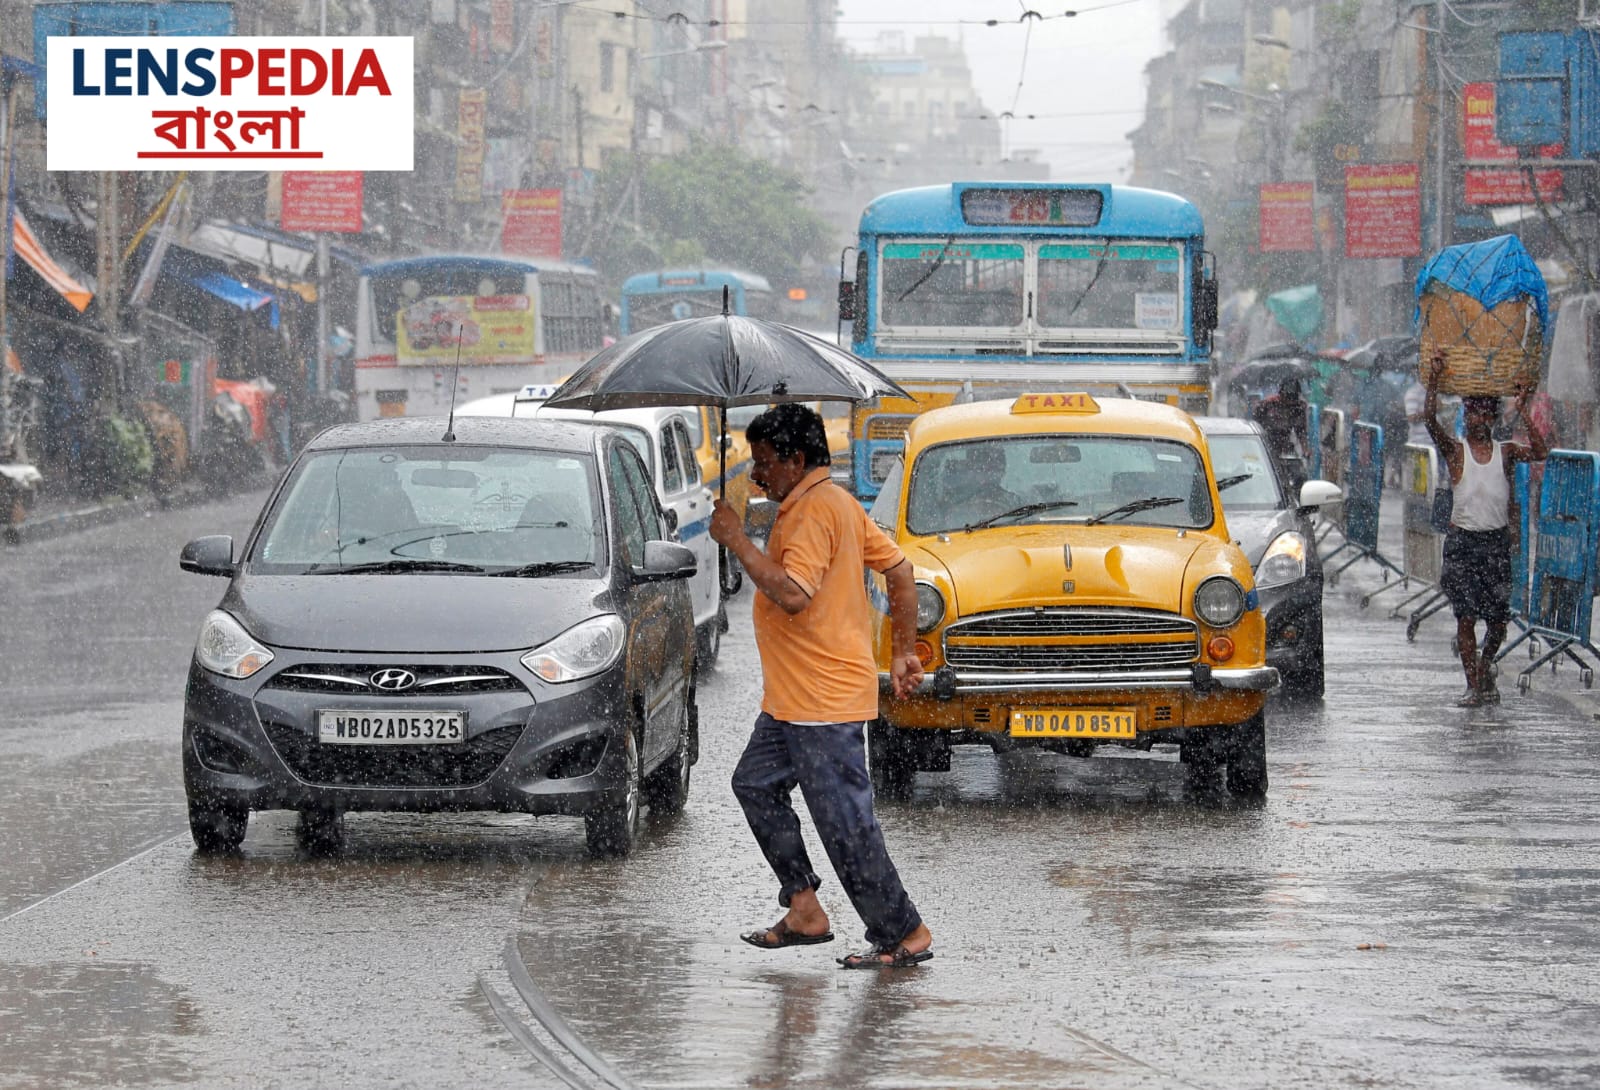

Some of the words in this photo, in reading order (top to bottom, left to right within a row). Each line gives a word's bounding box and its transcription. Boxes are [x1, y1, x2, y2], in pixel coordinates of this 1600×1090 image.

[1025, 395, 1085, 408] TAXI
[336, 717, 459, 739] WB02AD5325
[1024, 714, 1044, 732] WB
[1049, 714, 1070, 732] 04
[1075, 715, 1085, 732] D
[1090, 714, 1132, 733] 8511
